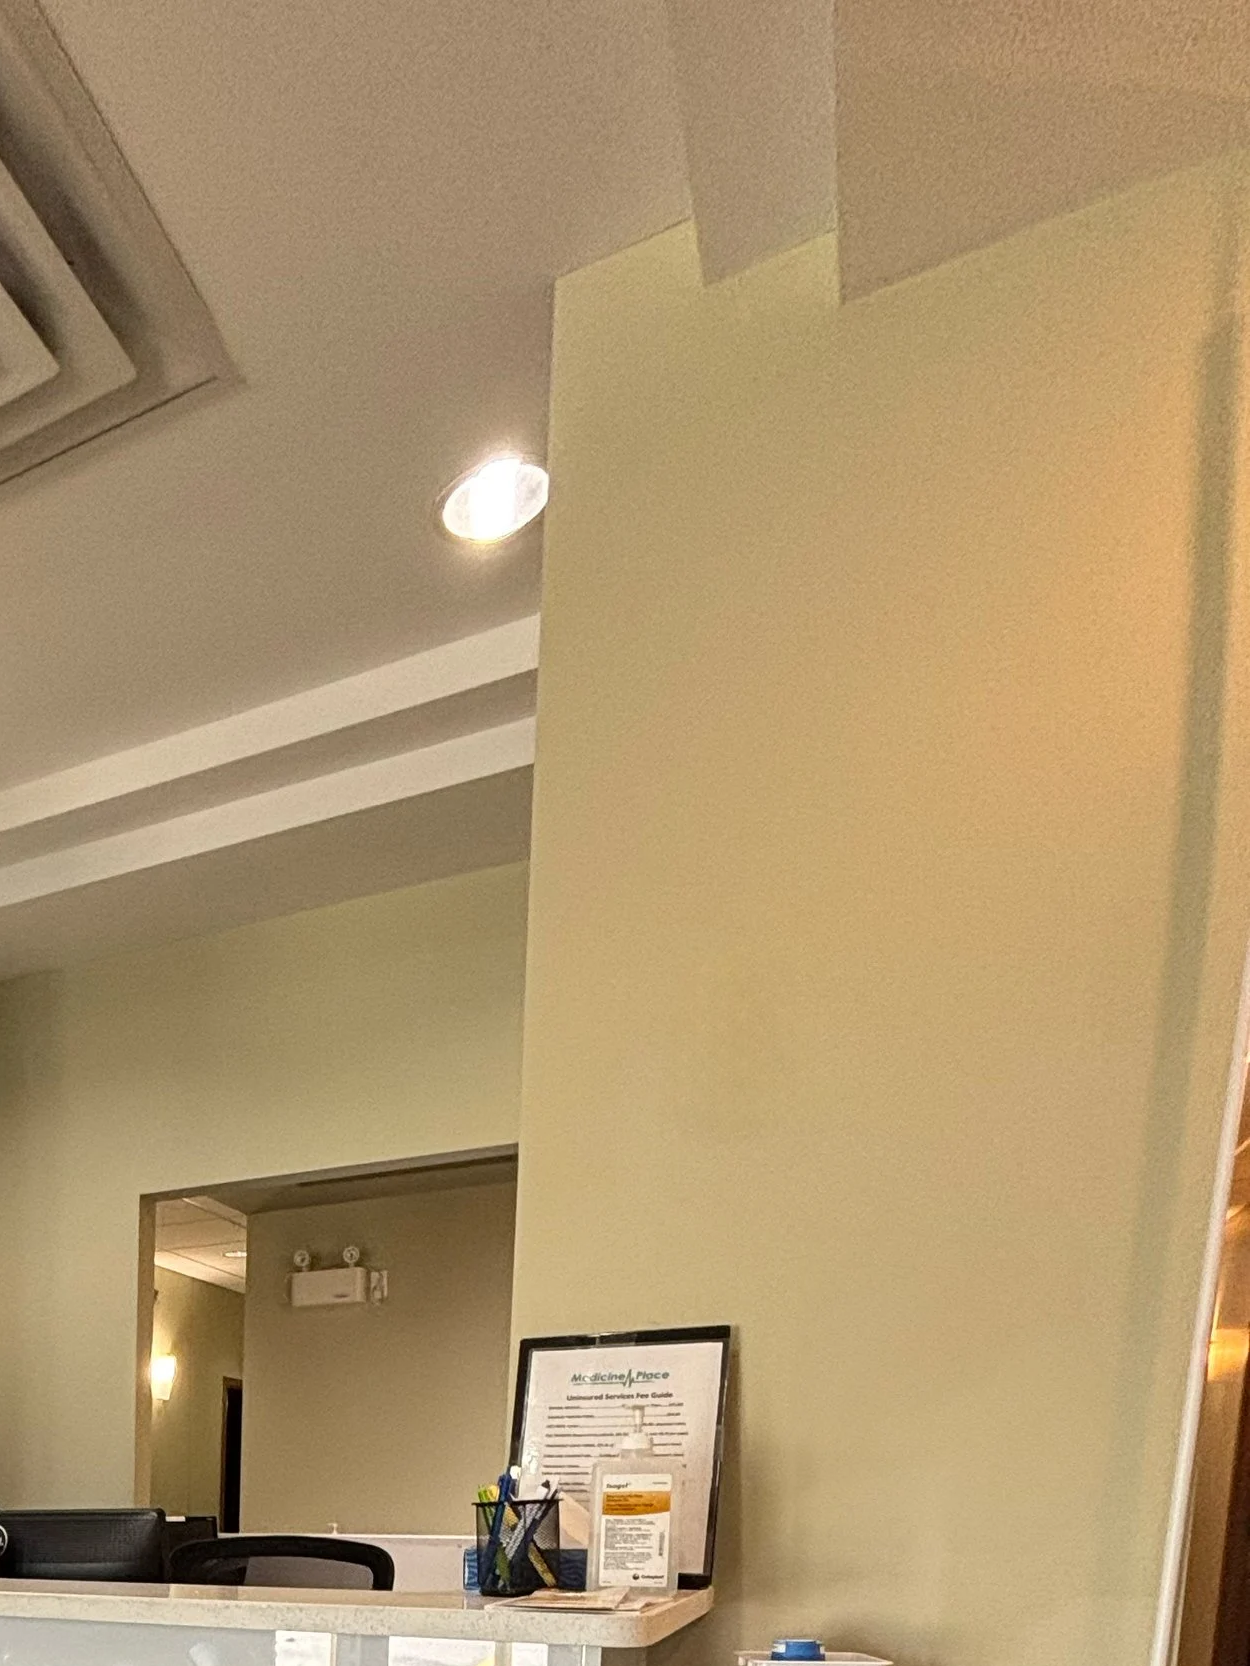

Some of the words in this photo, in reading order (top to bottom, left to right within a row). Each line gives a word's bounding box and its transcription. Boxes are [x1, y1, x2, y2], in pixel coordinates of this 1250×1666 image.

[635, 1370, 670, 1380] Place
[566, 1392, 604, 1401] Uninsured
[605, 1391, 635, 1400] Services
[636, 1391, 649, 1399] Fee
[651, 1391, 674, 1399] Guide
